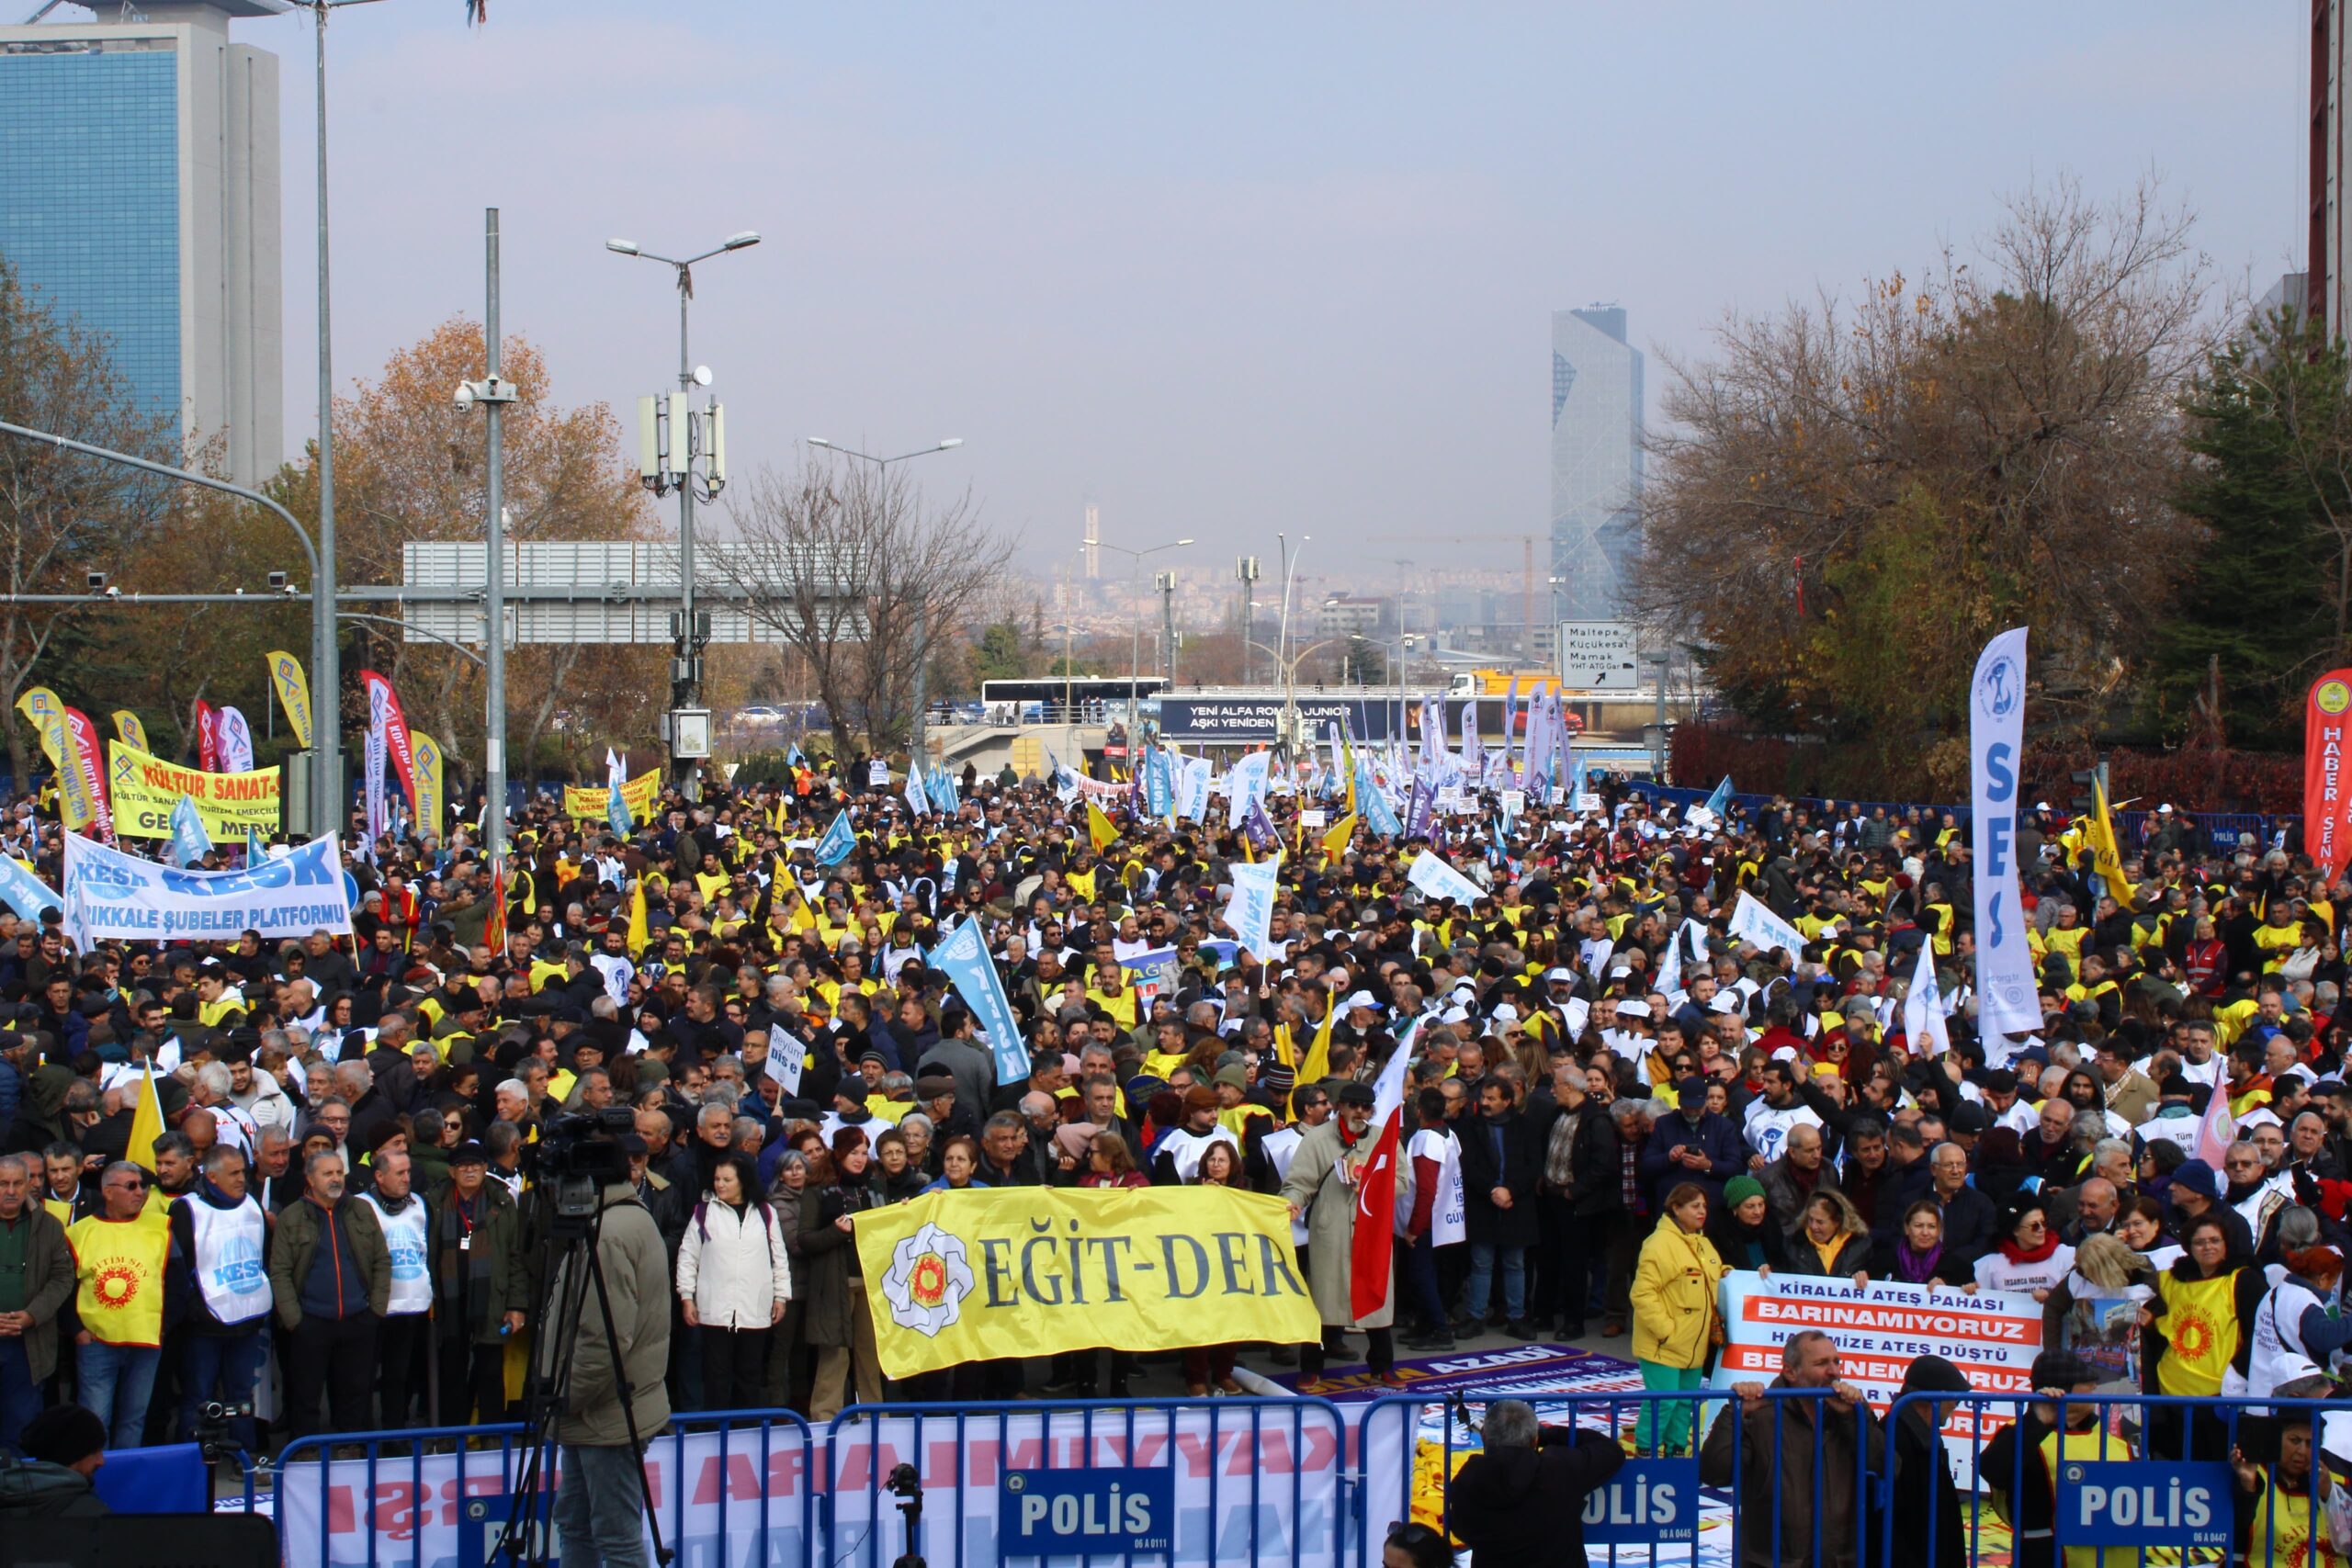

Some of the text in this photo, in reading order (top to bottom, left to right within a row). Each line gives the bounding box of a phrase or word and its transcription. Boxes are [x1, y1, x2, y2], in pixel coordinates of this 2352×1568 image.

[1570, 628, 1619, 637] Maltepe
[1570, 652, 1613, 660] Mamak
[1190, 705, 1218, 716] YENİ
[1221, 706, 1254, 716] ALFA
[1304, 706, 1351, 716] JUNIOR
[1190, 718, 1218, 729] AŞKI
[1221, 717, 1275, 728] YENİDEN
[142, 763, 206, 798] KÜLTÜR
[1152, 768, 1165, 814] KESK
[114, 792, 149, 803] KÜLTÜR
[1985, 742, 2013, 950] SES
[164, 909, 244, 933] ŞUBELER
[249, 904, 345, 928] PLATFORMU
[978, 1216, 1307, 1308] EĞİT-DER
[1780, 1280, 2005, 1312] KİRALAR ATEŞ PAHASI
[1758, 1302, 2024, 1340] BARINAMIYORUZ
[1939, 1344, 2007, 1362] DÜŞTÜ
[1020, 1482, 1151, 1536] POLİS
[1580, 1473, 1677, 1525] OLİS
[2080, 1476, 2211, 1527] POLİS
[1135, 1539, 1144, 1549] 06
[1150, 1538, 1167, 1549] 0111
